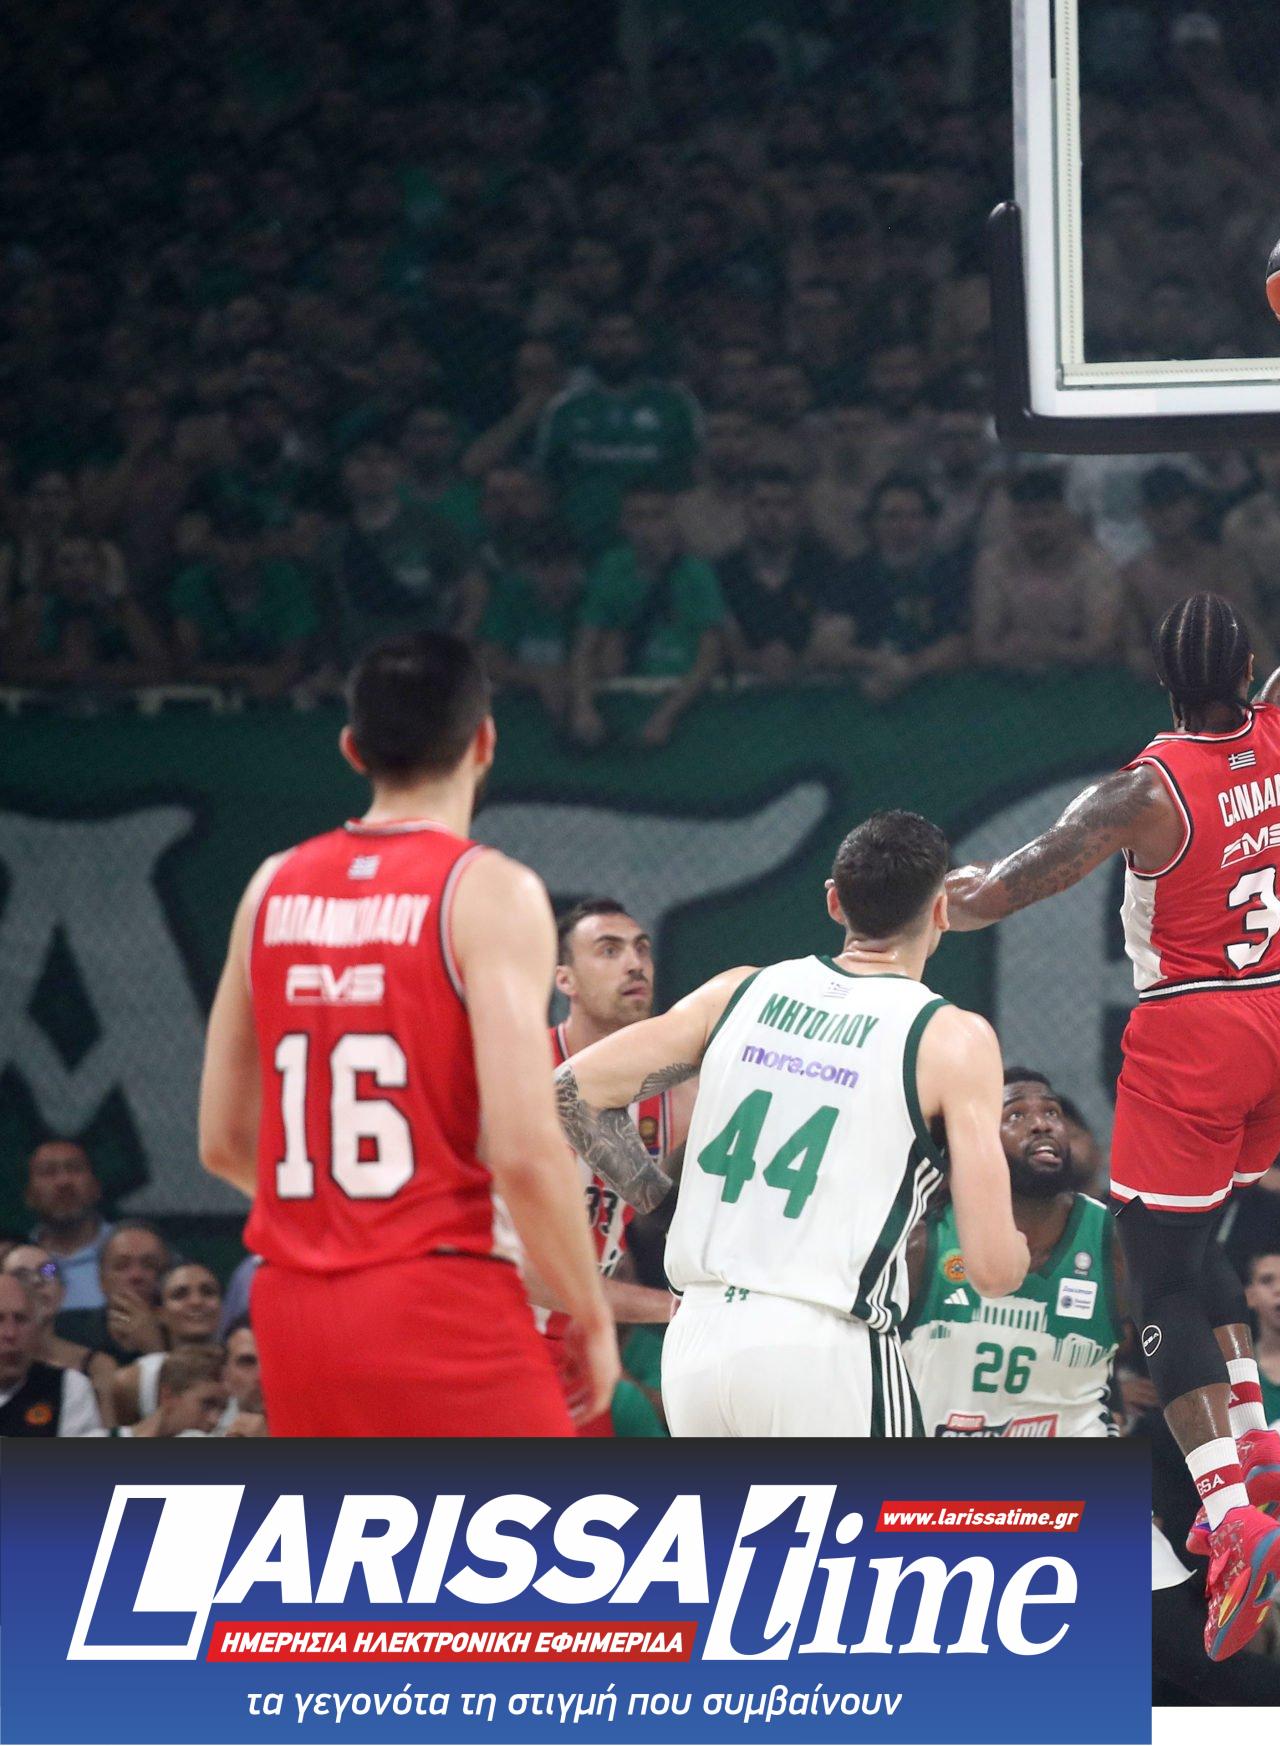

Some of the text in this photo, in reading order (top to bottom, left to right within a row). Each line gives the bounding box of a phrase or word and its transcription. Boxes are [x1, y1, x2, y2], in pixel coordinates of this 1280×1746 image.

[742, 1045, 860, 1089] more.com
[275, 1033, 415, 1200] 16
[697, 1088, 840, 1219] 44
[972, 1341, 1037, 1395] 26
[1196, 1473, 1225, 1496] GSA
